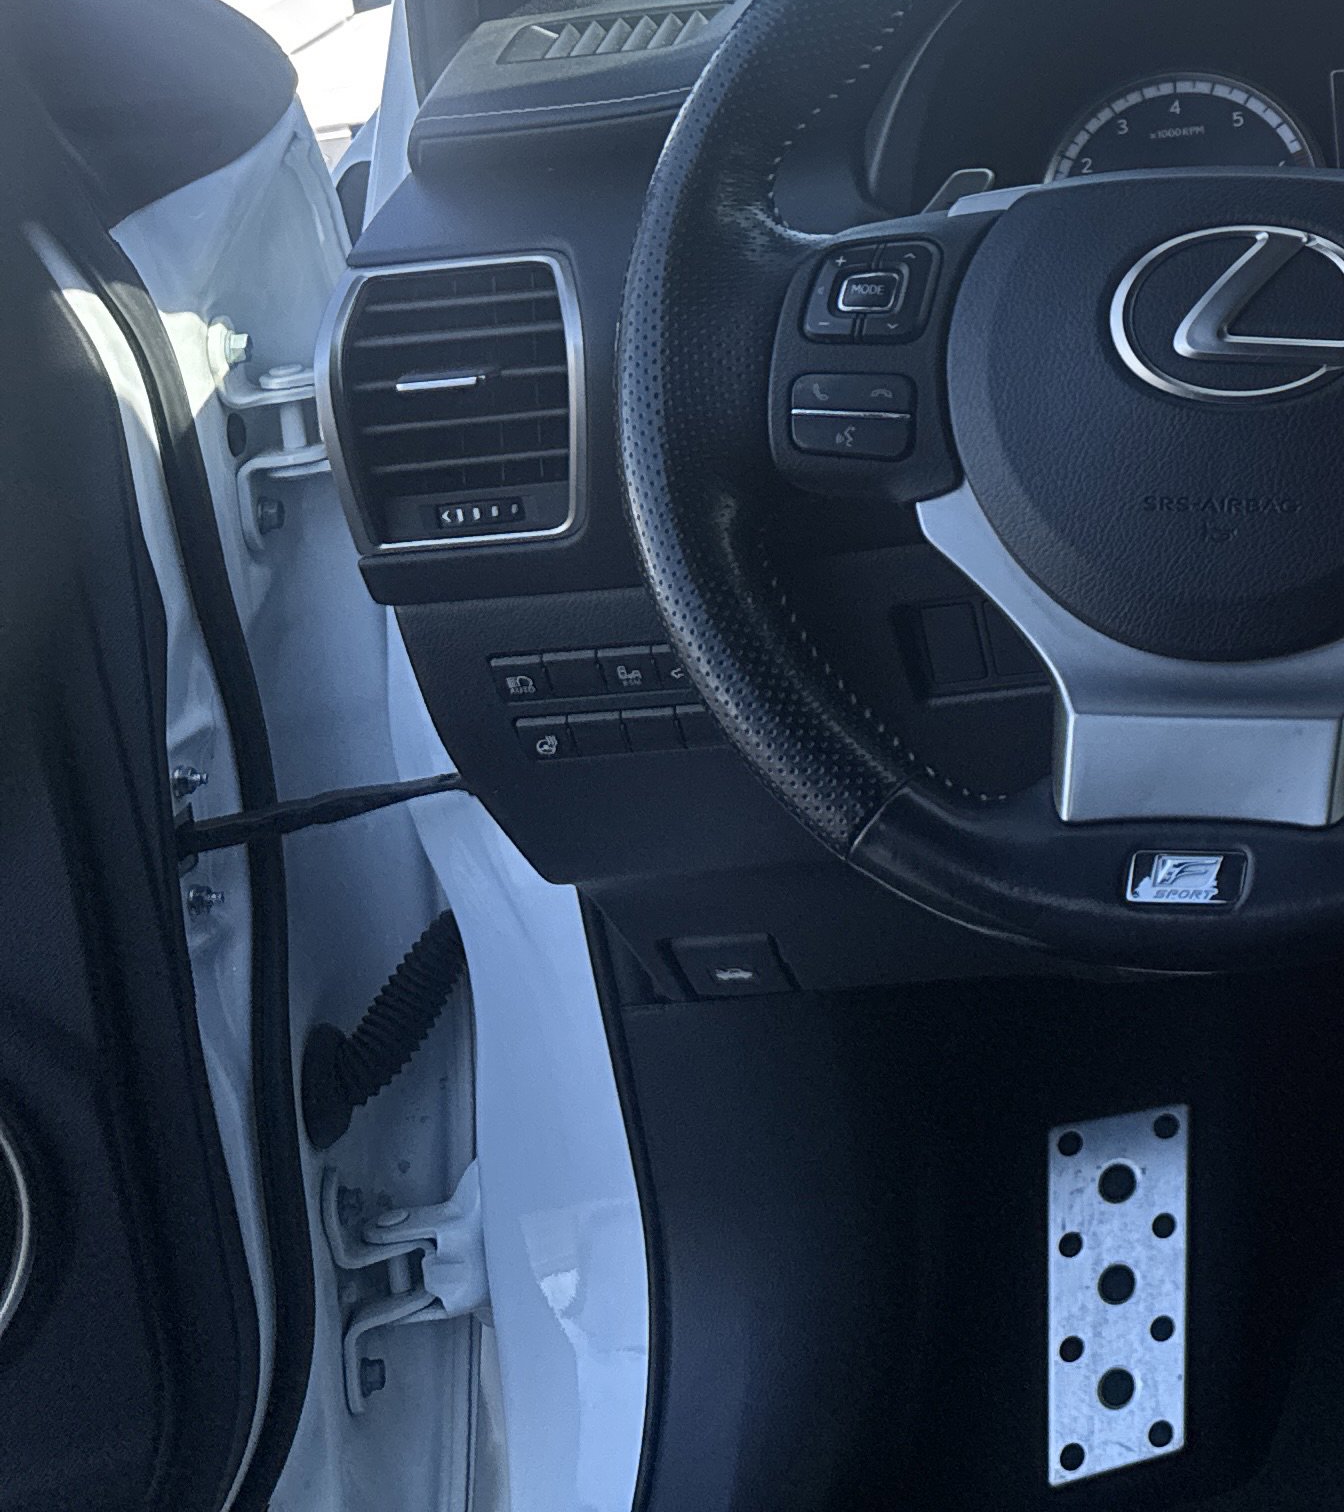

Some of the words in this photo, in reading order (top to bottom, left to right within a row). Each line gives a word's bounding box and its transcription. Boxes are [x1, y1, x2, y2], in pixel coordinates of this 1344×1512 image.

[1170, 100, 1181, 115] 4
[1232, 111, 1244, 127] 5
[1117, 119, 1129, 135] 3
[1081, 158, 1093, 174] 2
[851, 284, 885, 296] MODE
[1153, 889, 1214, 900] SPORT
